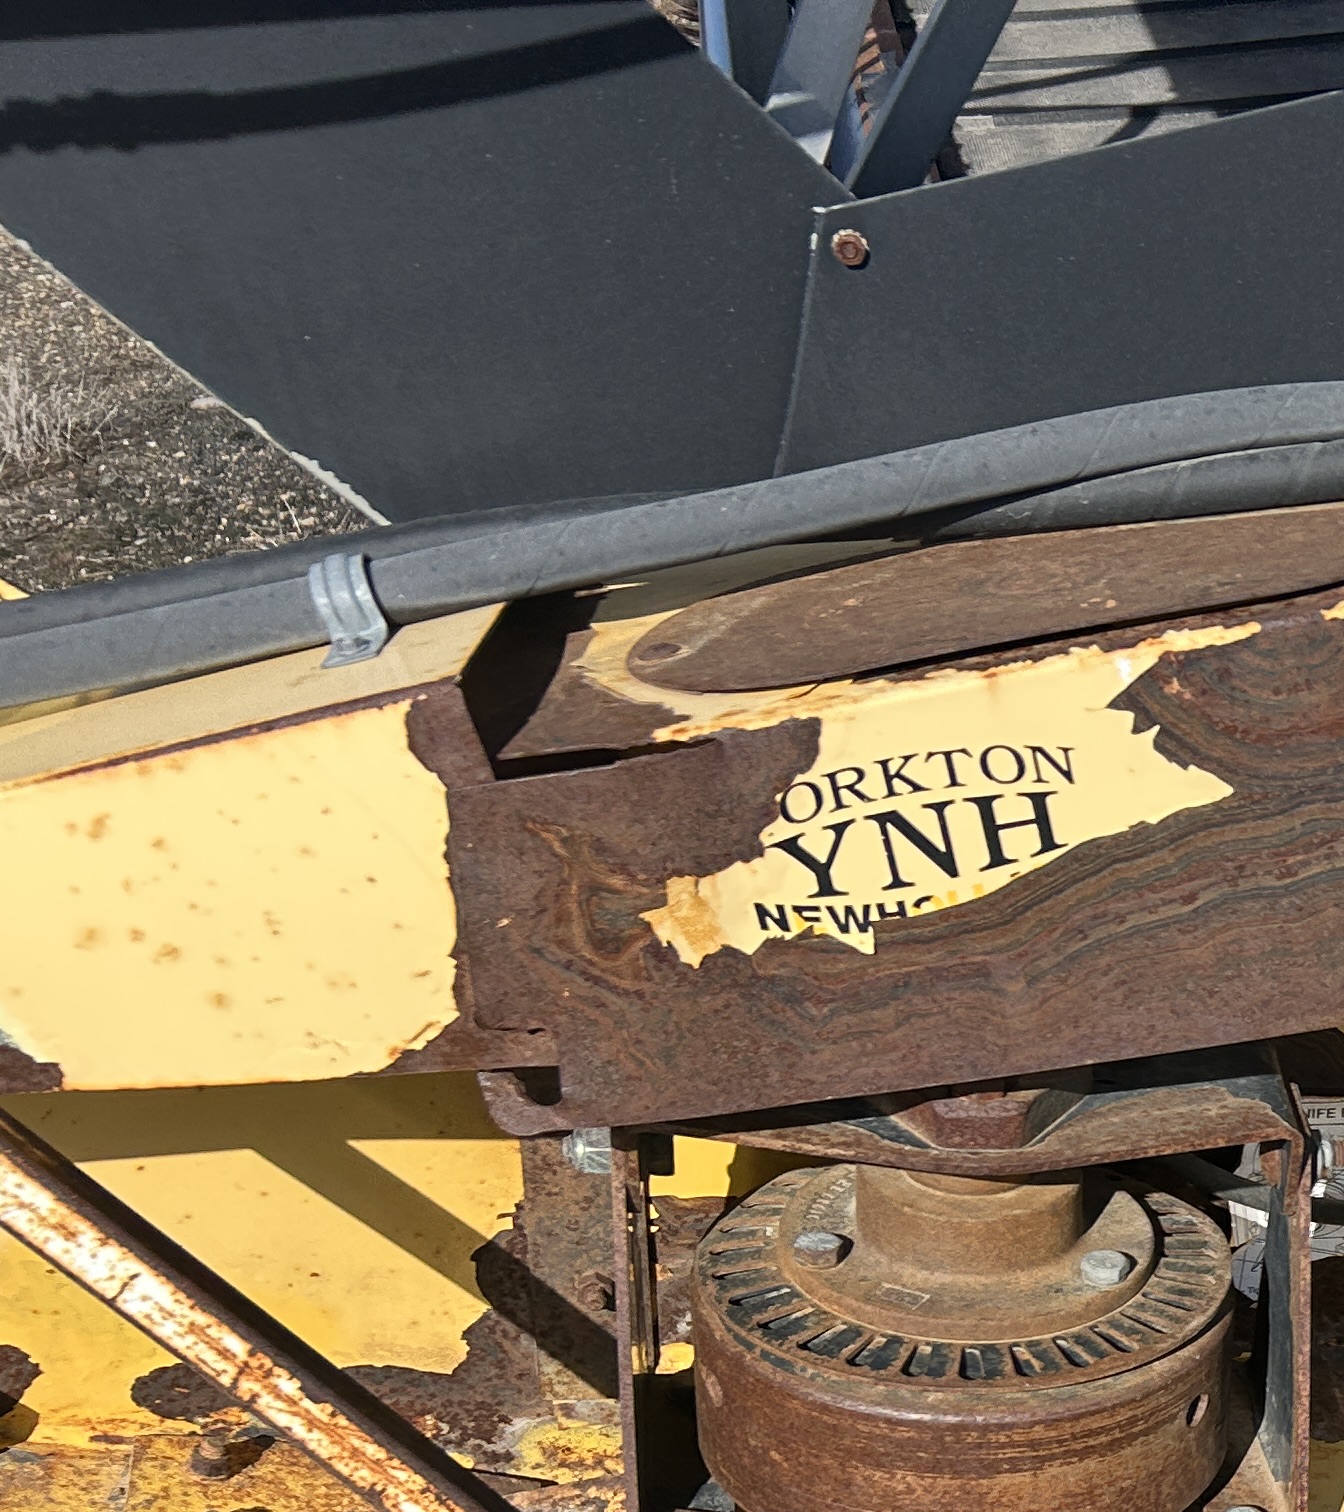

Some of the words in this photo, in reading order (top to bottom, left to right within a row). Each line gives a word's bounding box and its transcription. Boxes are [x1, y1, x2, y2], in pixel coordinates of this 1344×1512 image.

[780, 745, 1075, 824] ORKTON
[766, 791, 1069, 898] YNH
[1307, 1107, 1336, 1119] NIFE
